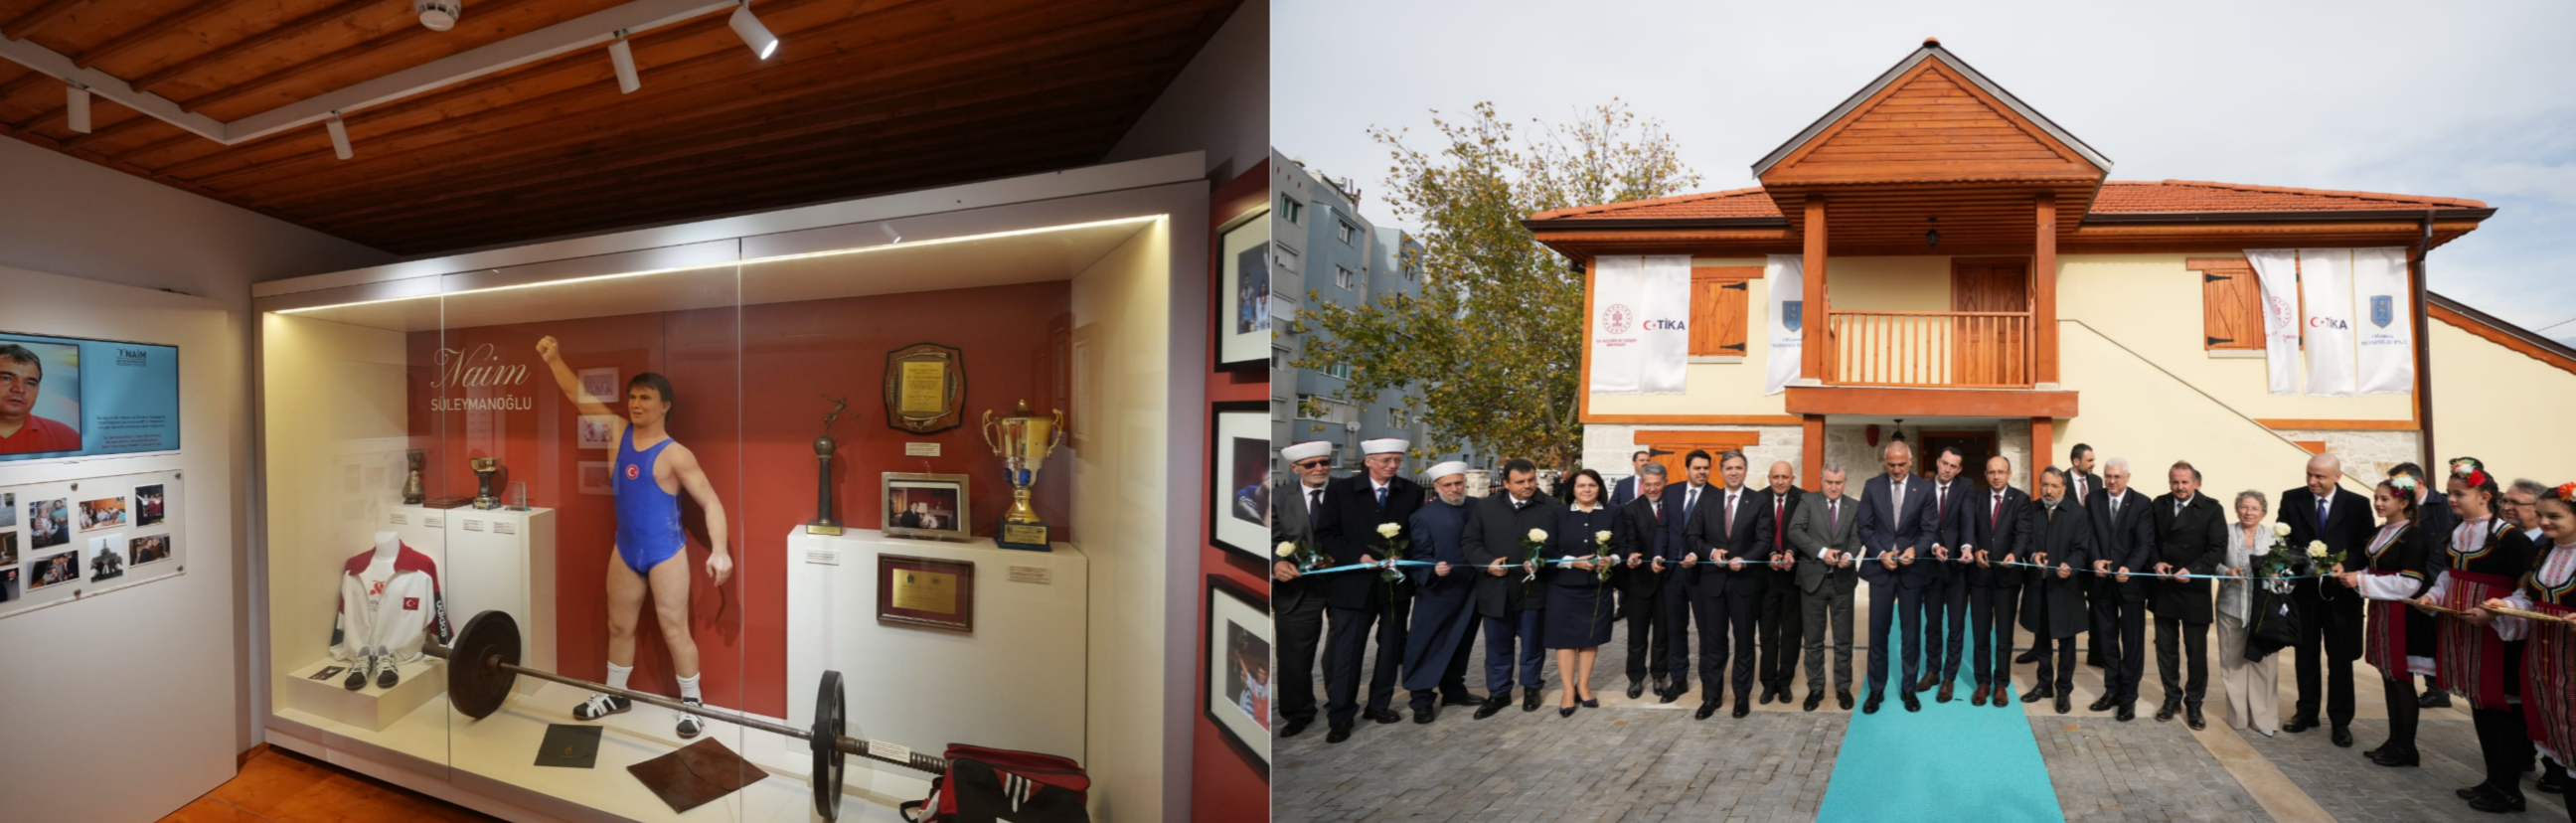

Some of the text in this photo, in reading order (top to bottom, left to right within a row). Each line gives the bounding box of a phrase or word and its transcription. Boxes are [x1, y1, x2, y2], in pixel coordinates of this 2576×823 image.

[1657, 318, 1686, 330] TİKA
[2324, 316, 2348, 330] TİKA
[430, 343, 531, 388] Naim
[430, 395, 532, 412] SÜLEYMANOĞLU
[435, 599, 447, 637] adidas
